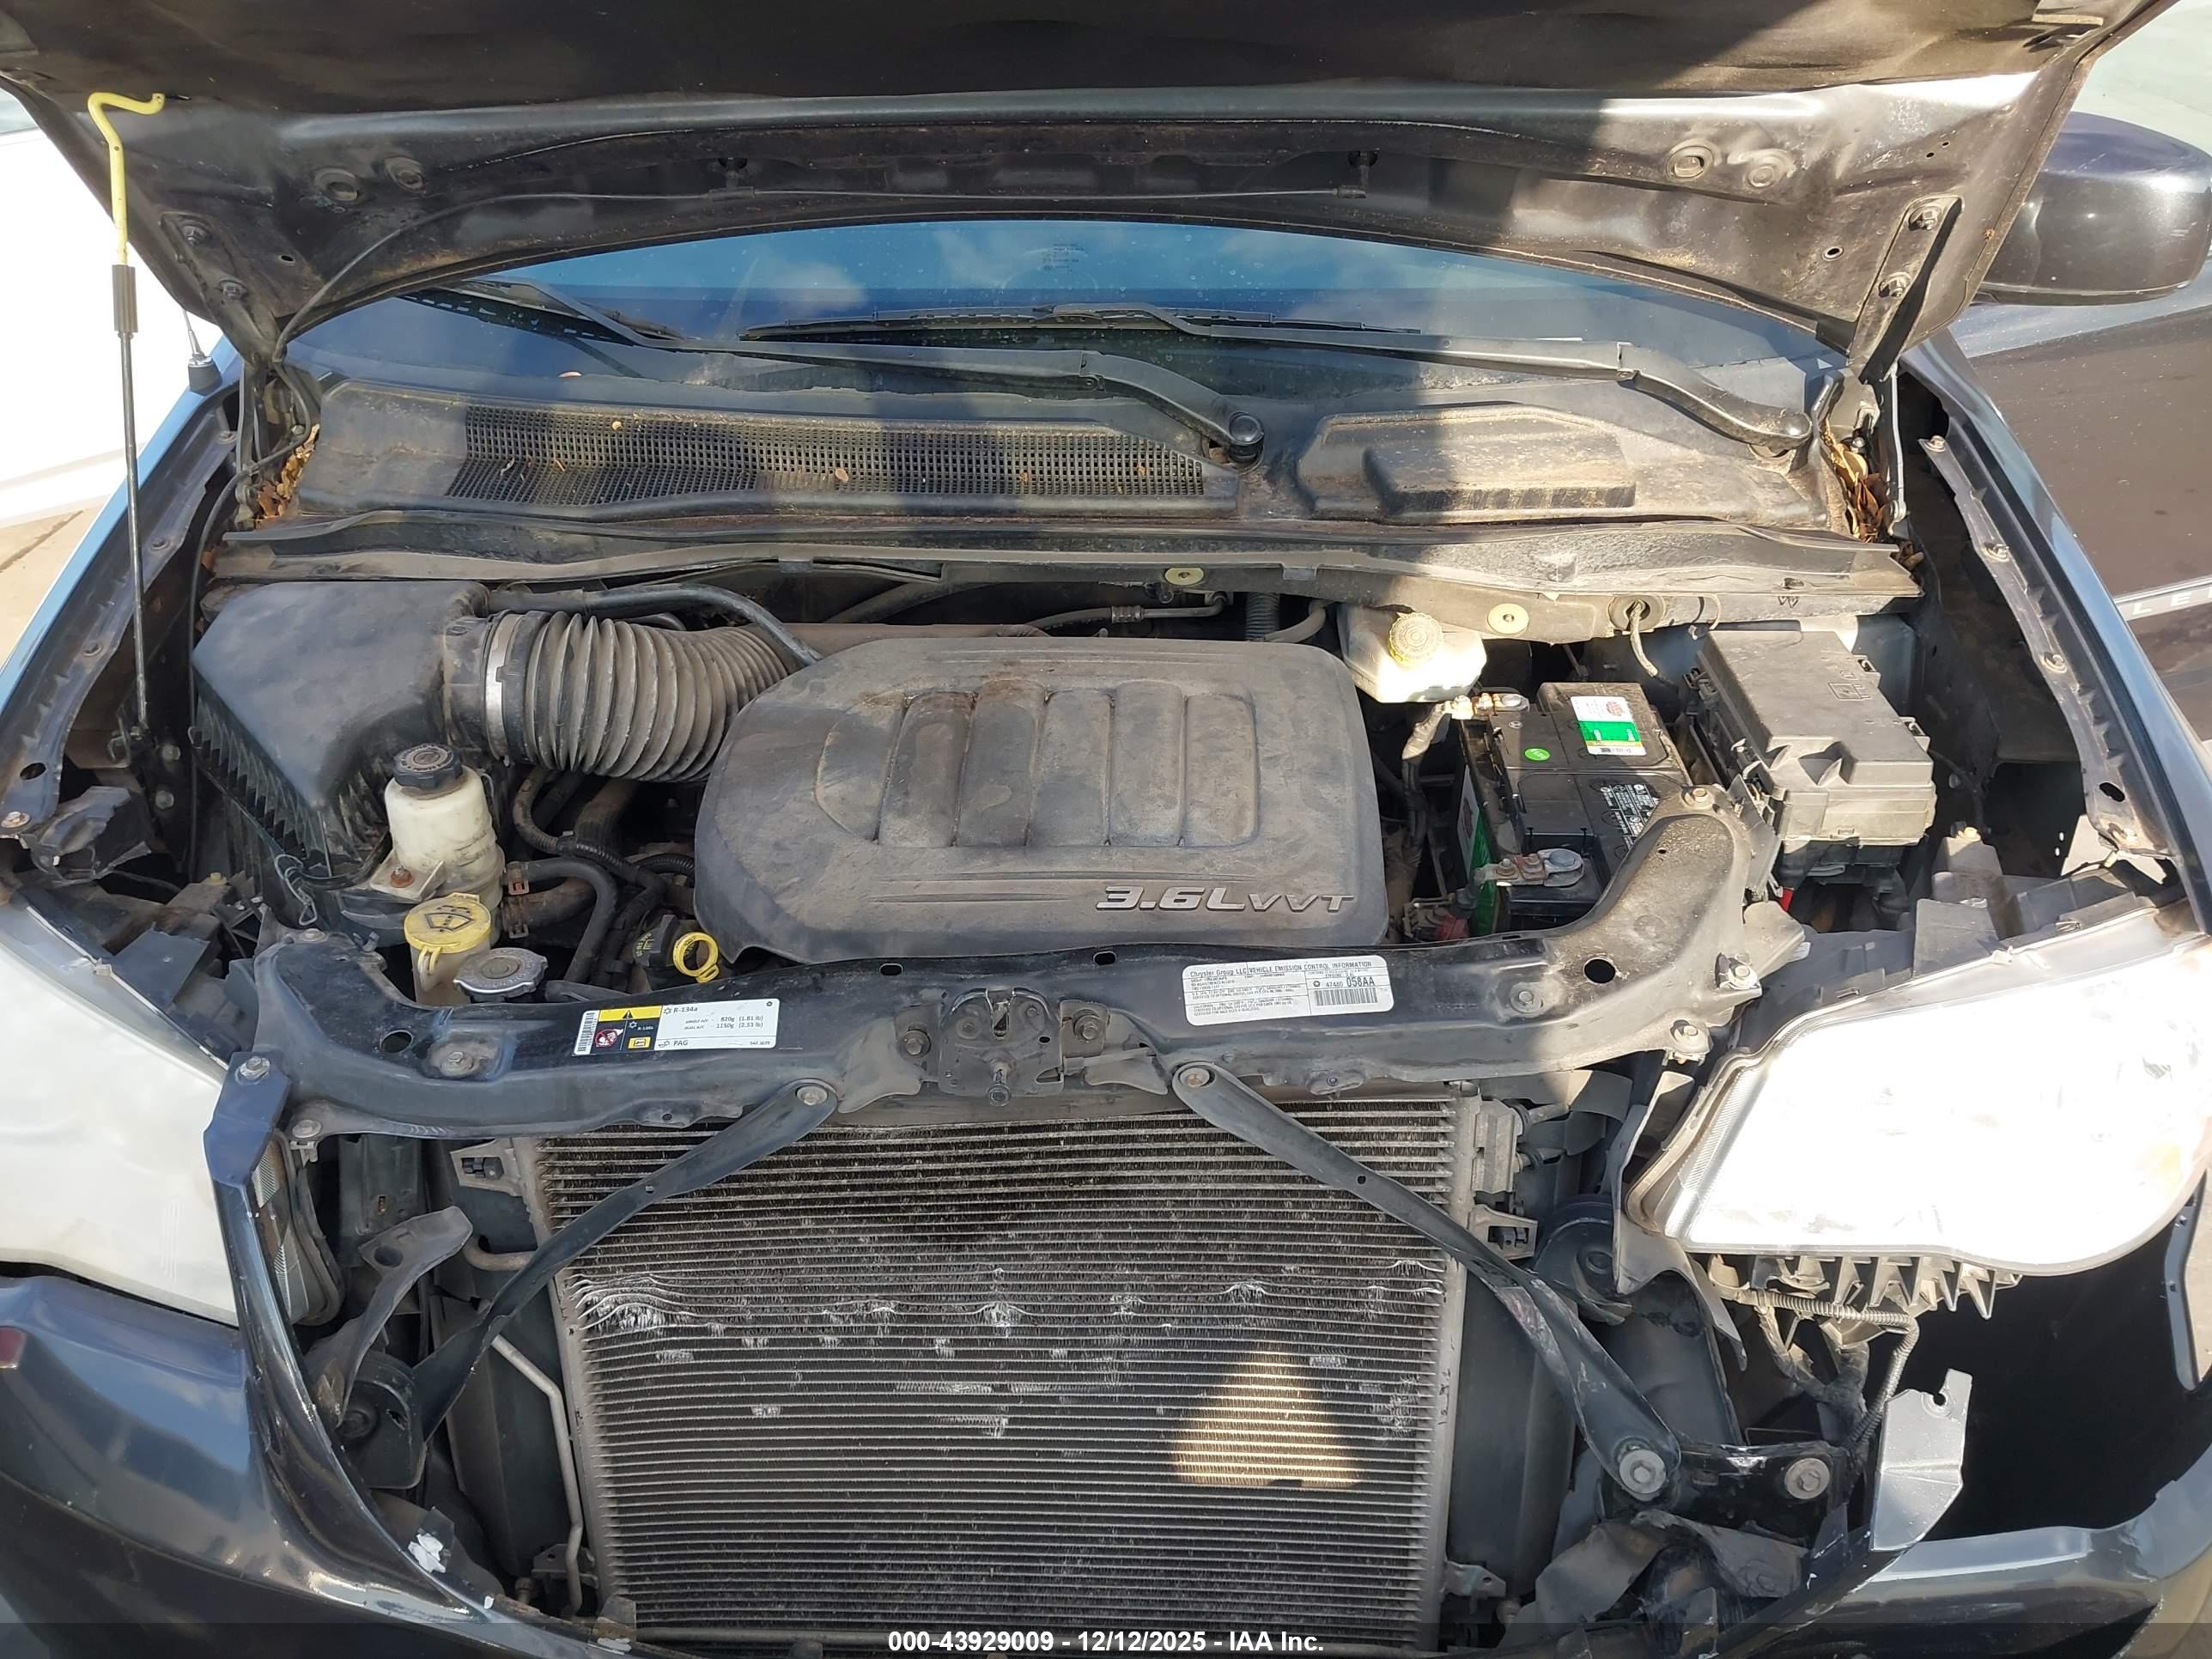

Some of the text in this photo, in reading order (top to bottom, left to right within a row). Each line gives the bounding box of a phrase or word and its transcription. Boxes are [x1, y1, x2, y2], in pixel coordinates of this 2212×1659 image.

[1096, 885, 1354, 914] 3.6L VVT
[1346, 975, 1376, 988] 058AA
